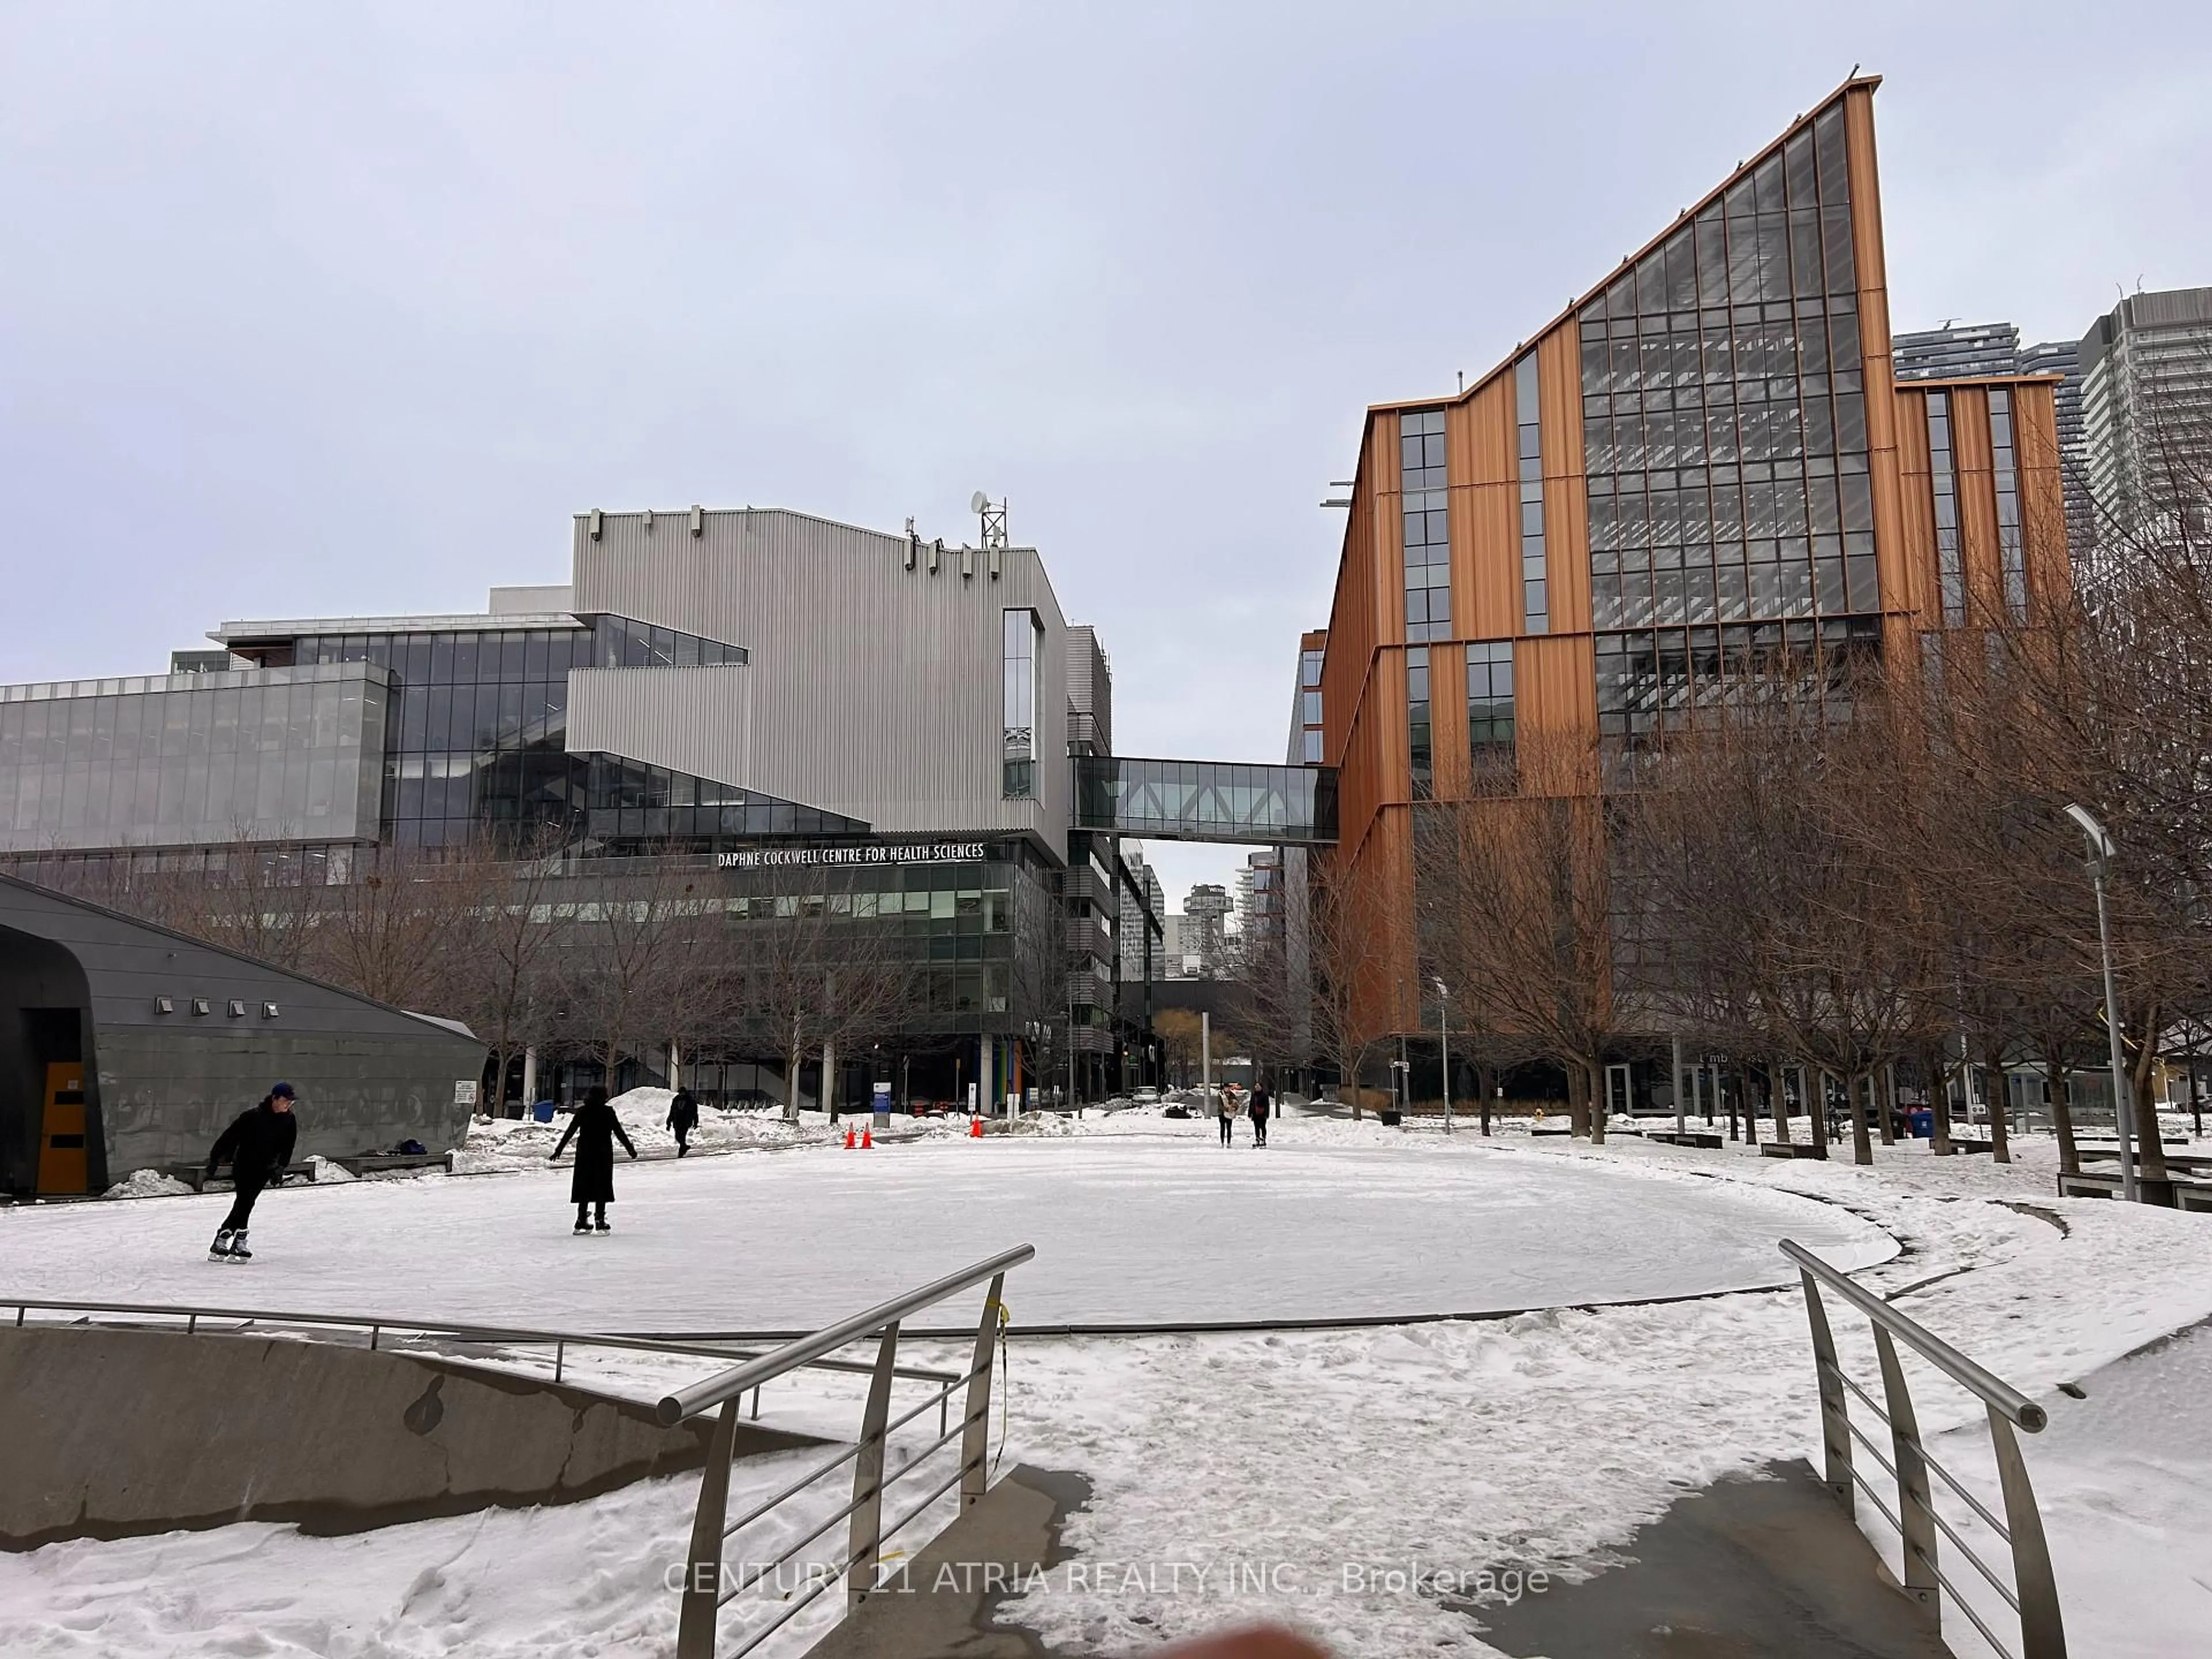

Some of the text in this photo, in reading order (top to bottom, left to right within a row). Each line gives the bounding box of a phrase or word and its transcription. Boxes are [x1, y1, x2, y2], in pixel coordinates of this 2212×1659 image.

[718, 843, 984, 866] DAPHNE COCKWELL CENTRE FOR HEALTH SCIENCES
